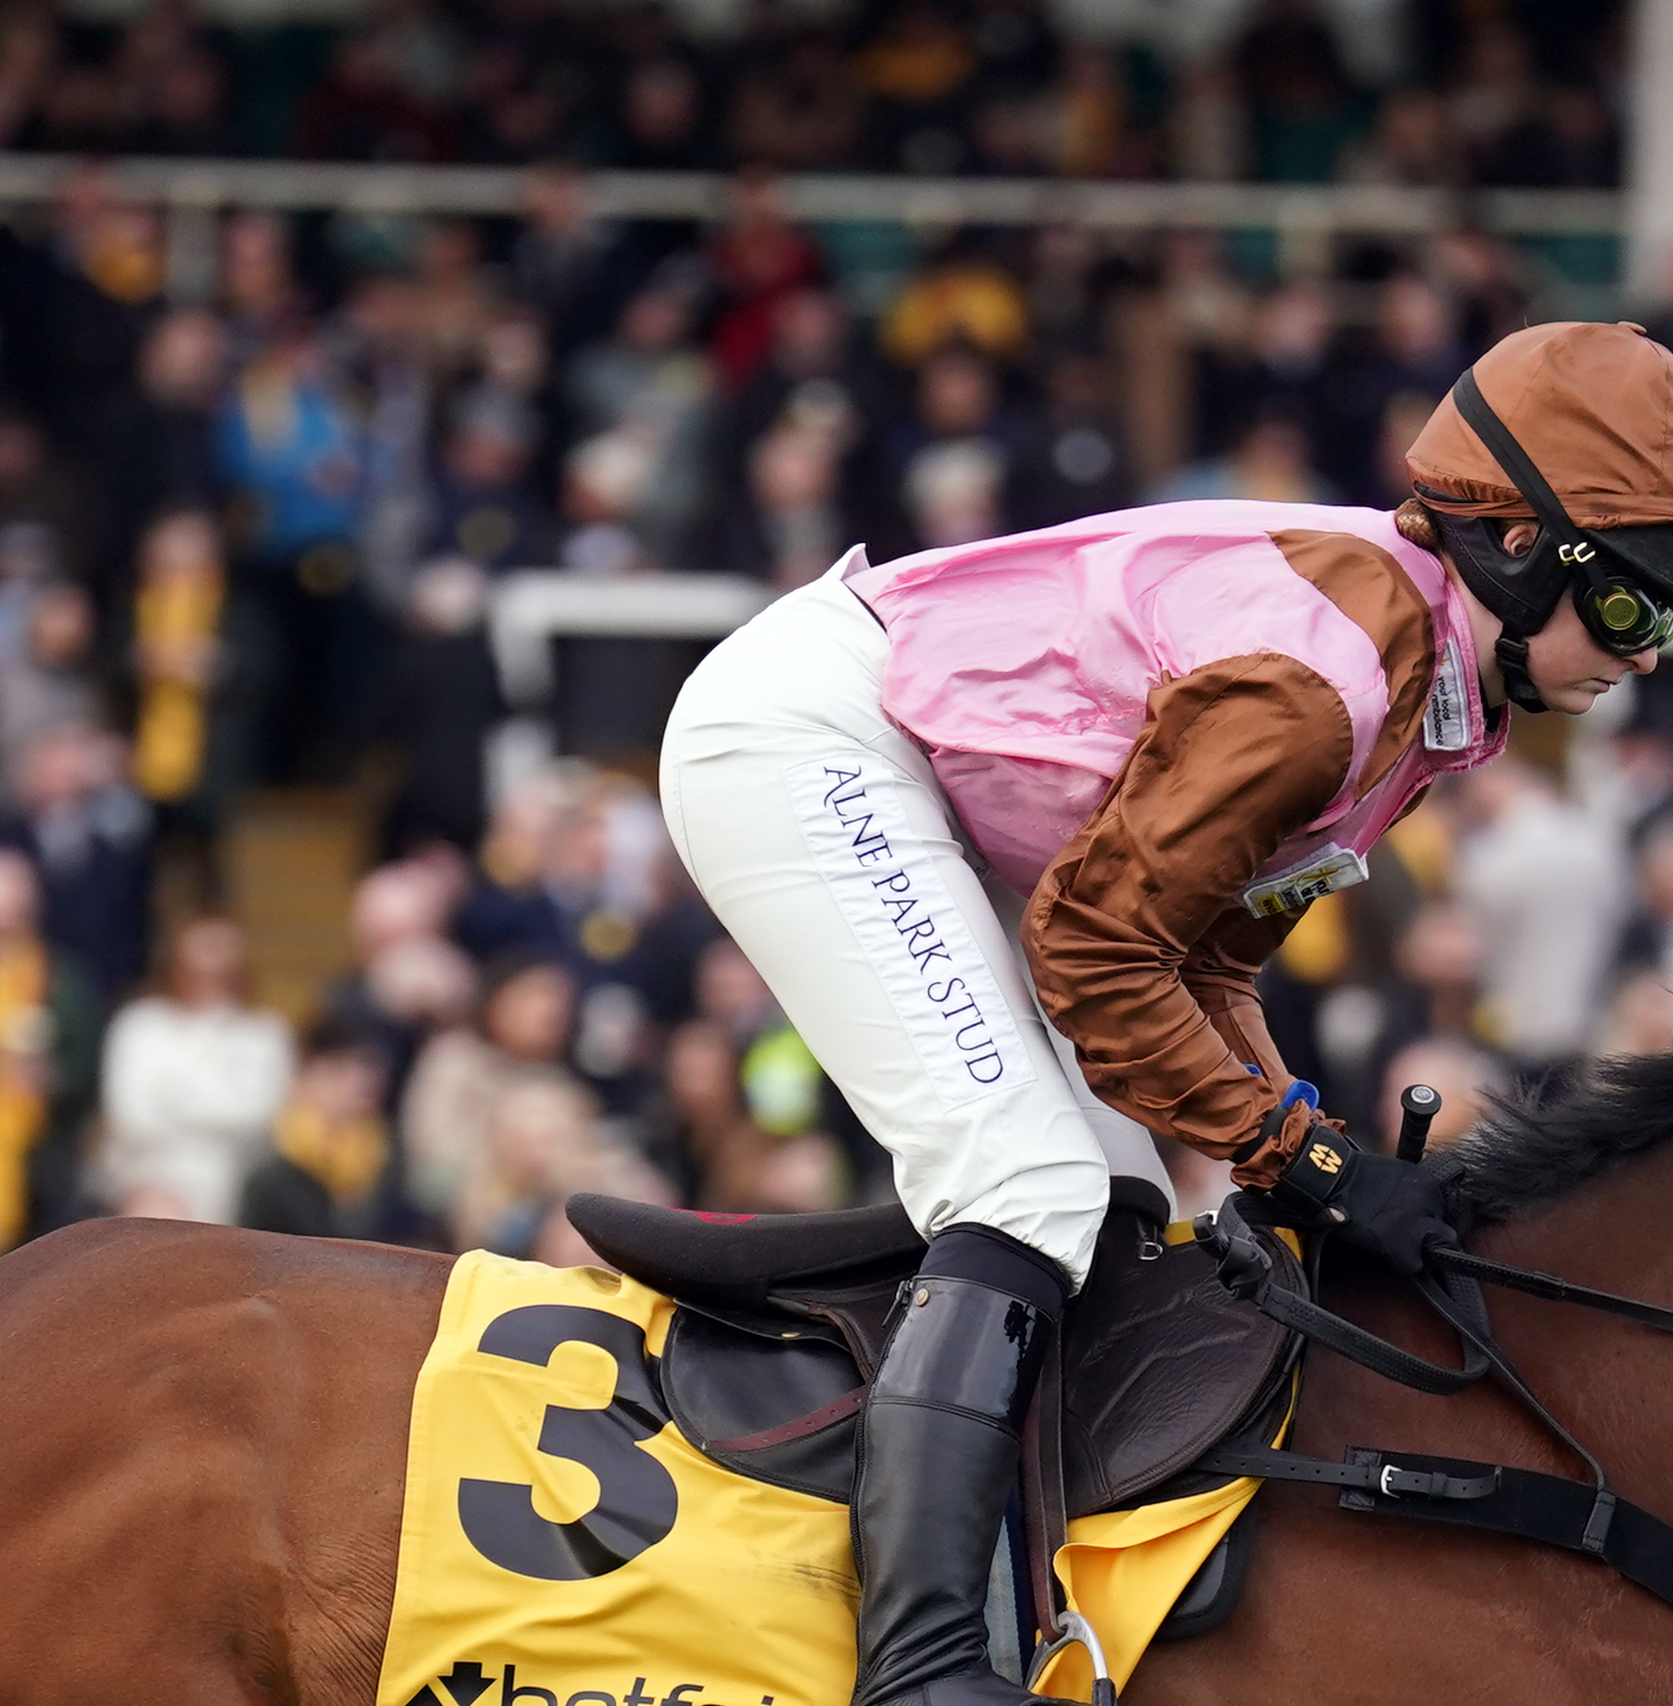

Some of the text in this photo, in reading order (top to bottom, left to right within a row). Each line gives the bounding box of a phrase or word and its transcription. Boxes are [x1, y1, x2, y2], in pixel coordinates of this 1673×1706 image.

[1442, 699, 1451, 720] local
[823, 765, 1004, 1084] ALNE PARK STUD
[458, 1304, 678, 1581] 3
